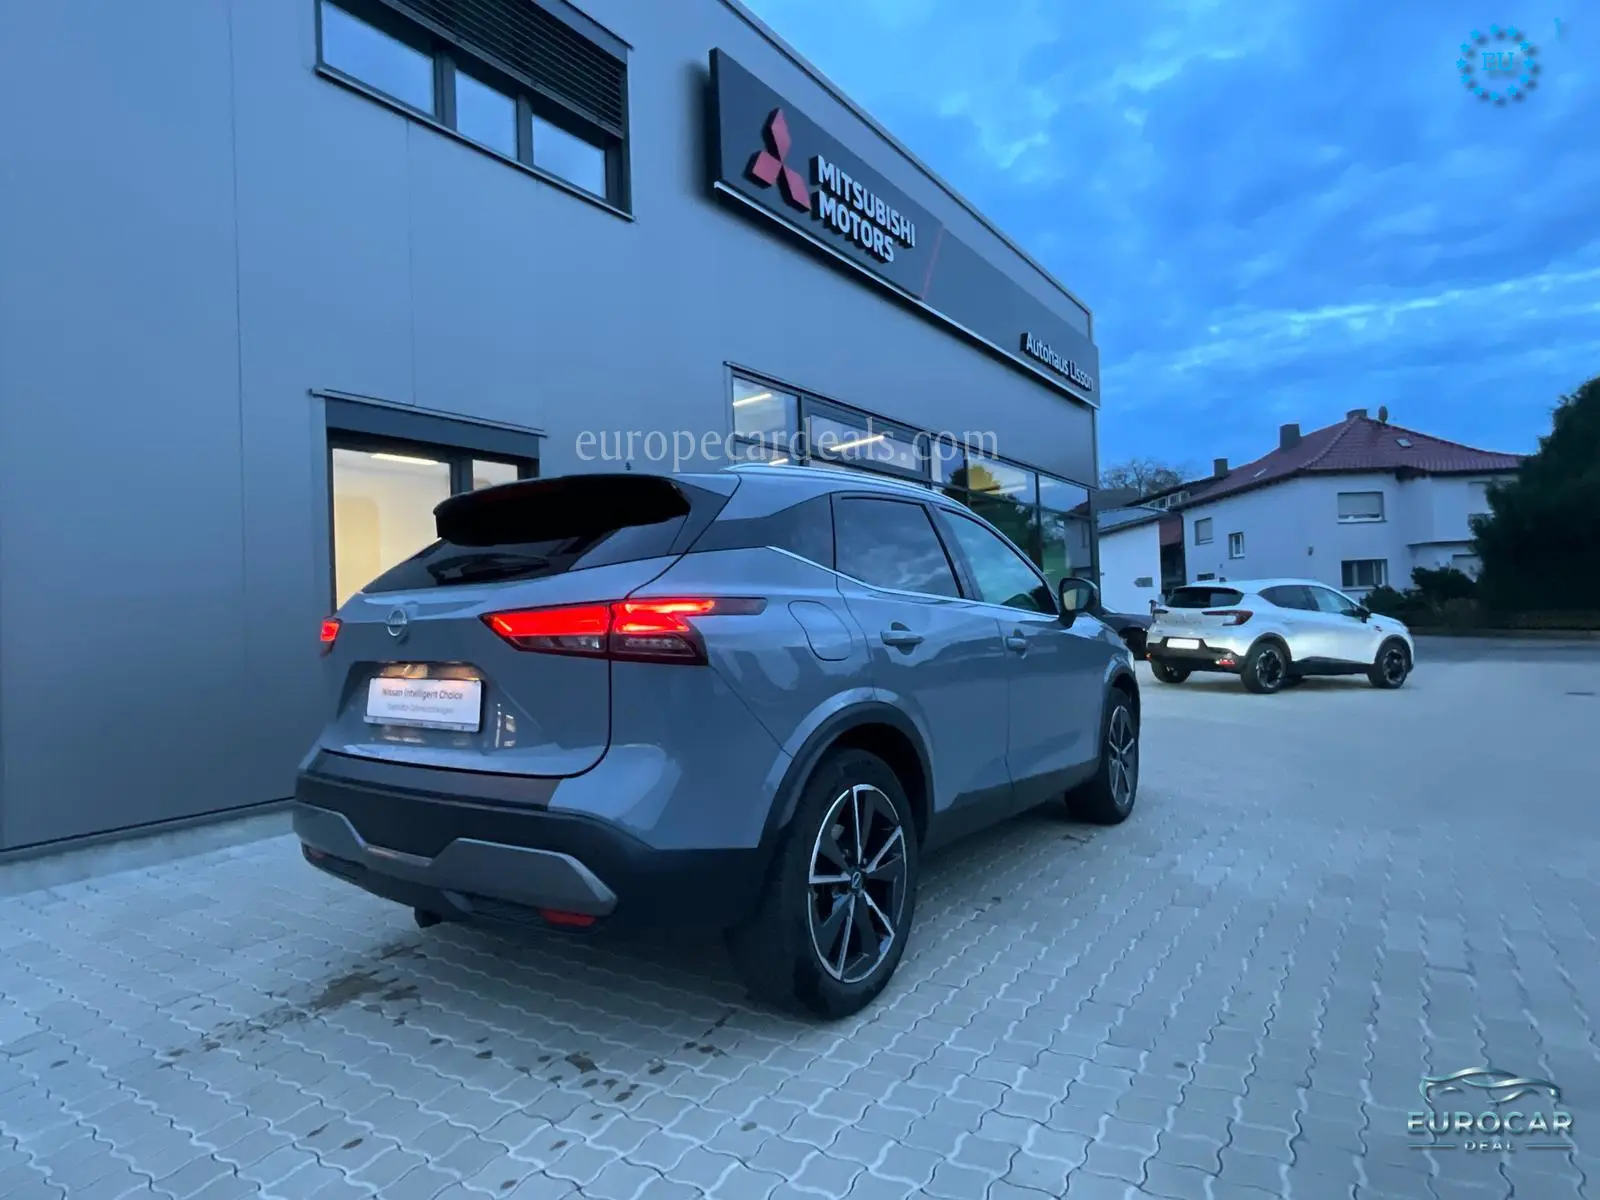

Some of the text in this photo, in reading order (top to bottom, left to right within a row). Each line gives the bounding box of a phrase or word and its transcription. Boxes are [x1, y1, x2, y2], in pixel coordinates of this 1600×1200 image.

[817, 154, 916, 248] MITSUBISHI
[819, 190, 895, 262] MOTORS
[1026, 332, 1069, 376] Autohaus
[382, 687, 464, 701] Nissan Intelligent Choice
